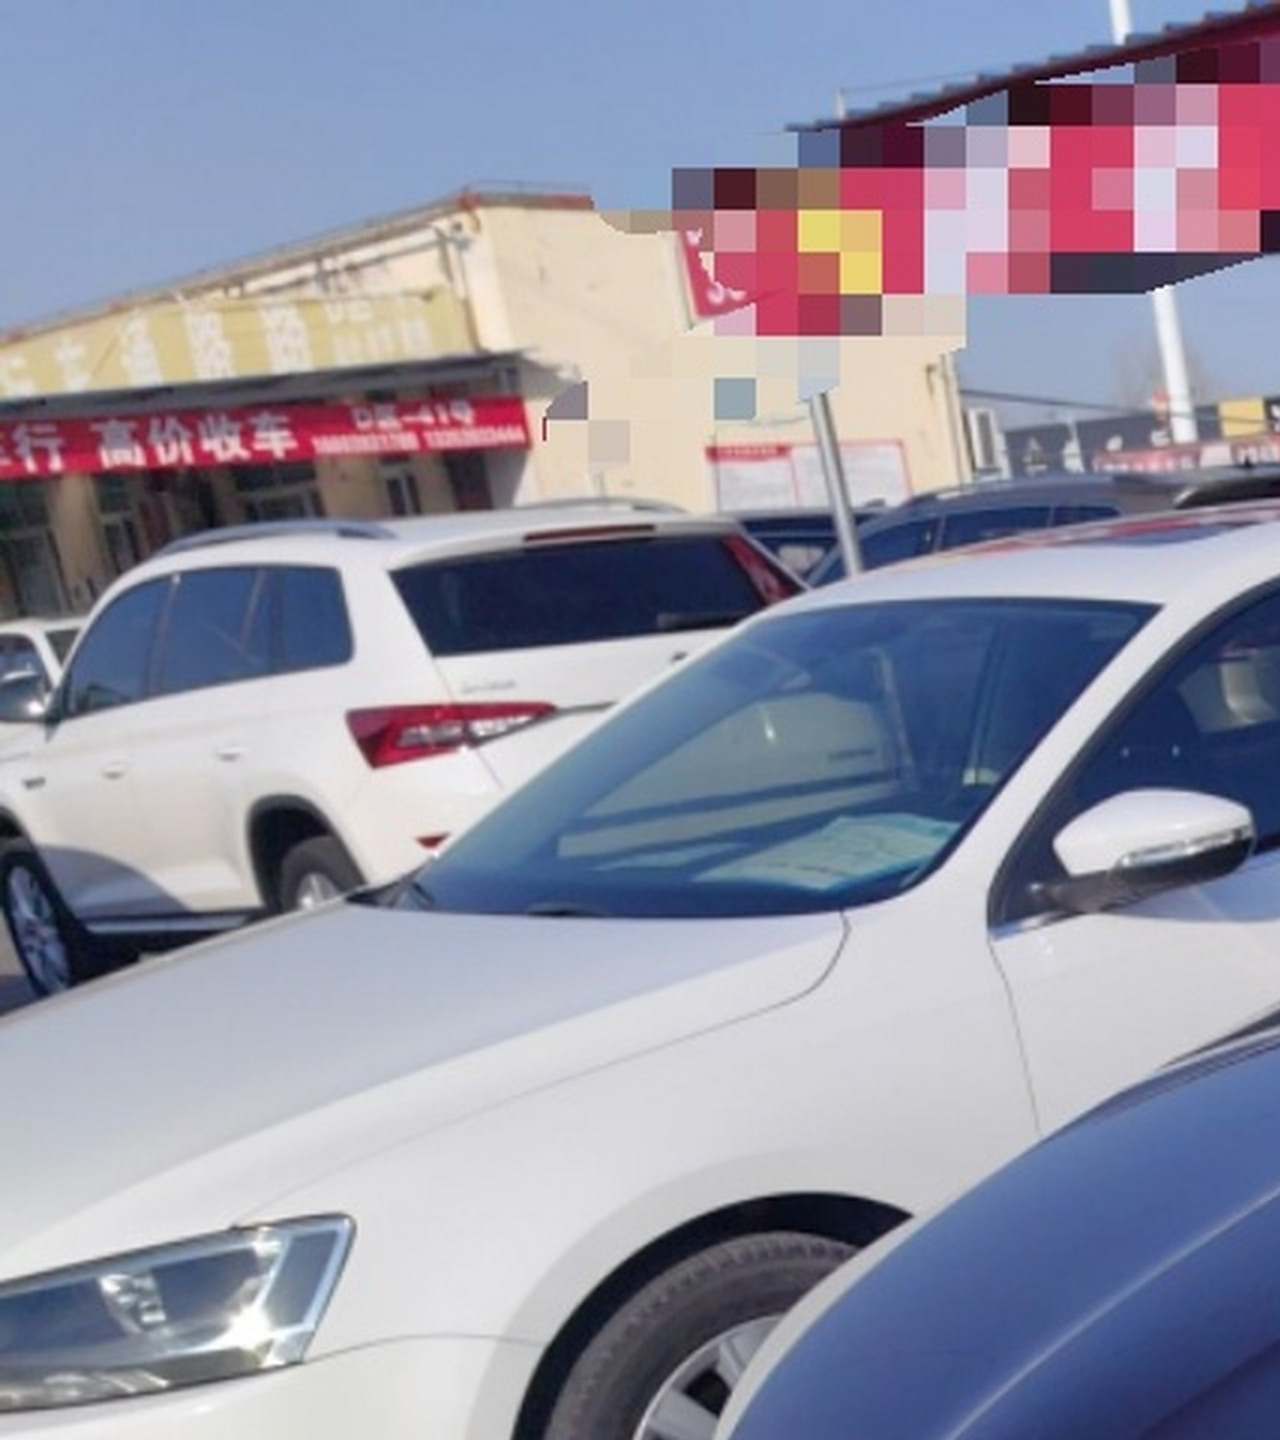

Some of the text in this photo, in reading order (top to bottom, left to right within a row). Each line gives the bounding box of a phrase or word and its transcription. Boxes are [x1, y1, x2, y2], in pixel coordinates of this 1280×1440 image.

[0, 421, 63, 473] 行
[90, 411, 299, 469] 高价收车
